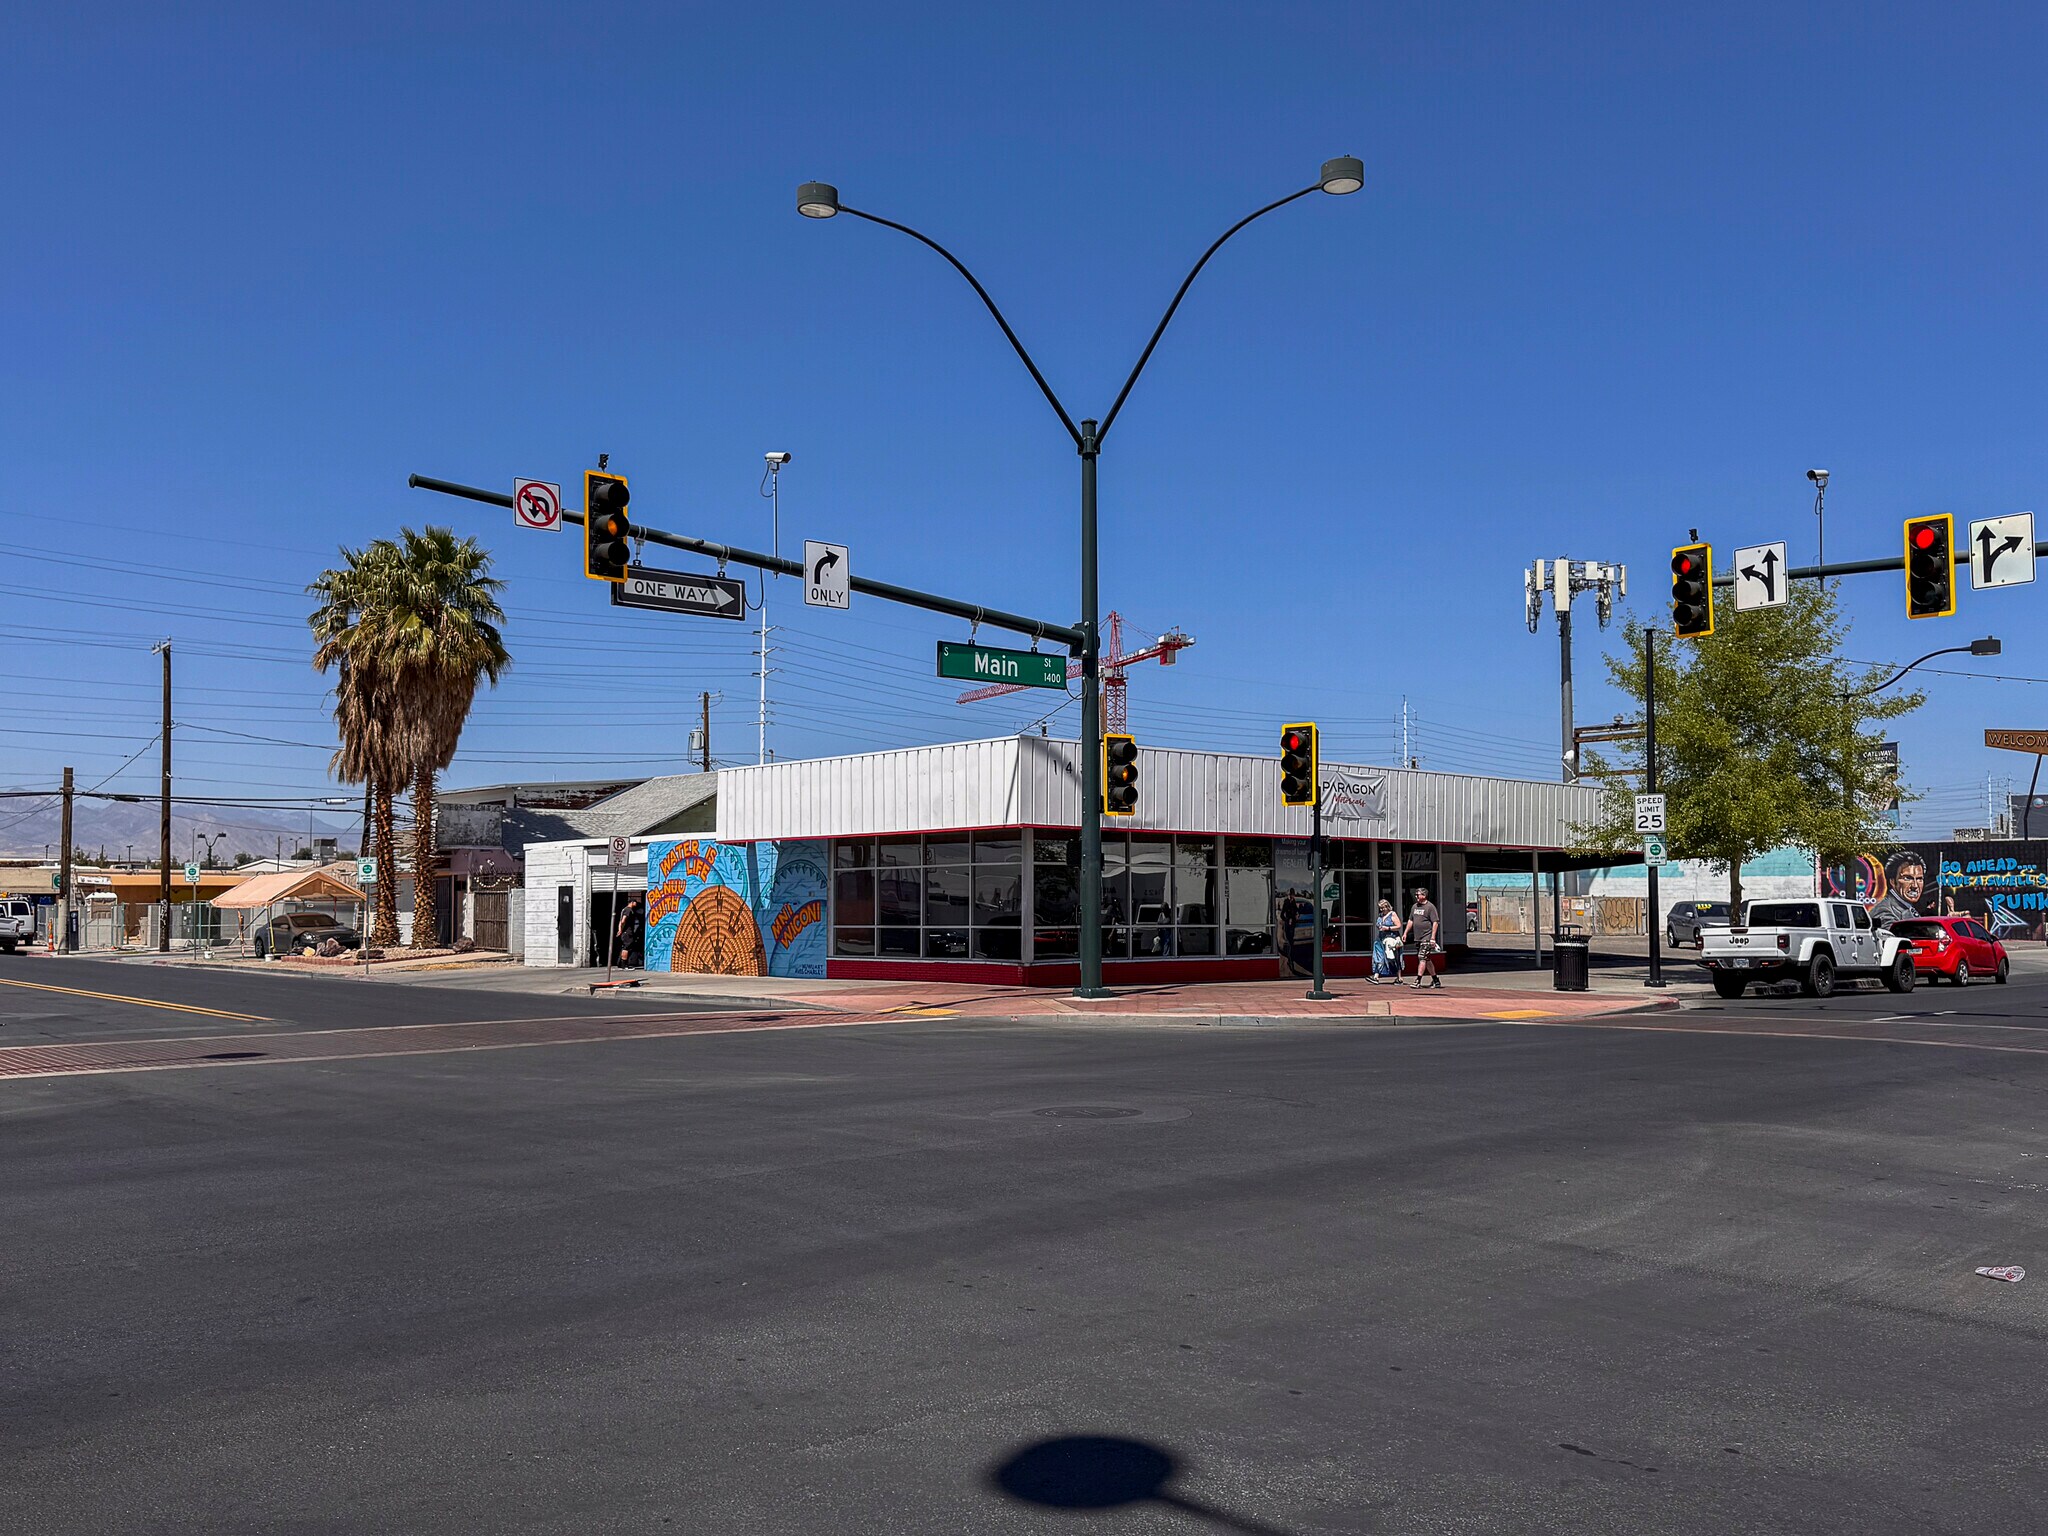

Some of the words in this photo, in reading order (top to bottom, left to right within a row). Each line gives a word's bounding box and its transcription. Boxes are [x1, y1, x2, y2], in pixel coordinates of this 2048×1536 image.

[634, 581, 666, 597] ONE
[674, 587, 708, 602] WAY
[811, 588, 844, 603] ONLY
[943, 646, 949, 657] S
[974, 652, 1018, 677] Main
[1044, 657, 1052, 668] St
[1044, 672, 1061, 683] 1400
[1322, 781, 1377, 796] PARAGON
[1637, 797, 1663, 805] SPEED
[1638, 815, 1663, 829] 25
[660, 839, 700, 878] WATER
[705, 845, 718, 866] IS
[1941, 860, 1961, 873] GO
[686, 858, 712, 883] LIFE
[1936, 874, 1970, 887] HAVE
[1976, 875, 1984, 886] A
[1986, 874, 2035, 887] SWELL
[1991, 892, 2048, 911] PUNK
[649, 896, 681, 926] QUITH
[771, 902, 794, 942] MNI
[780, 901, 821, 950] WICONI
[1729, 936, 1750, 945] Jeep
